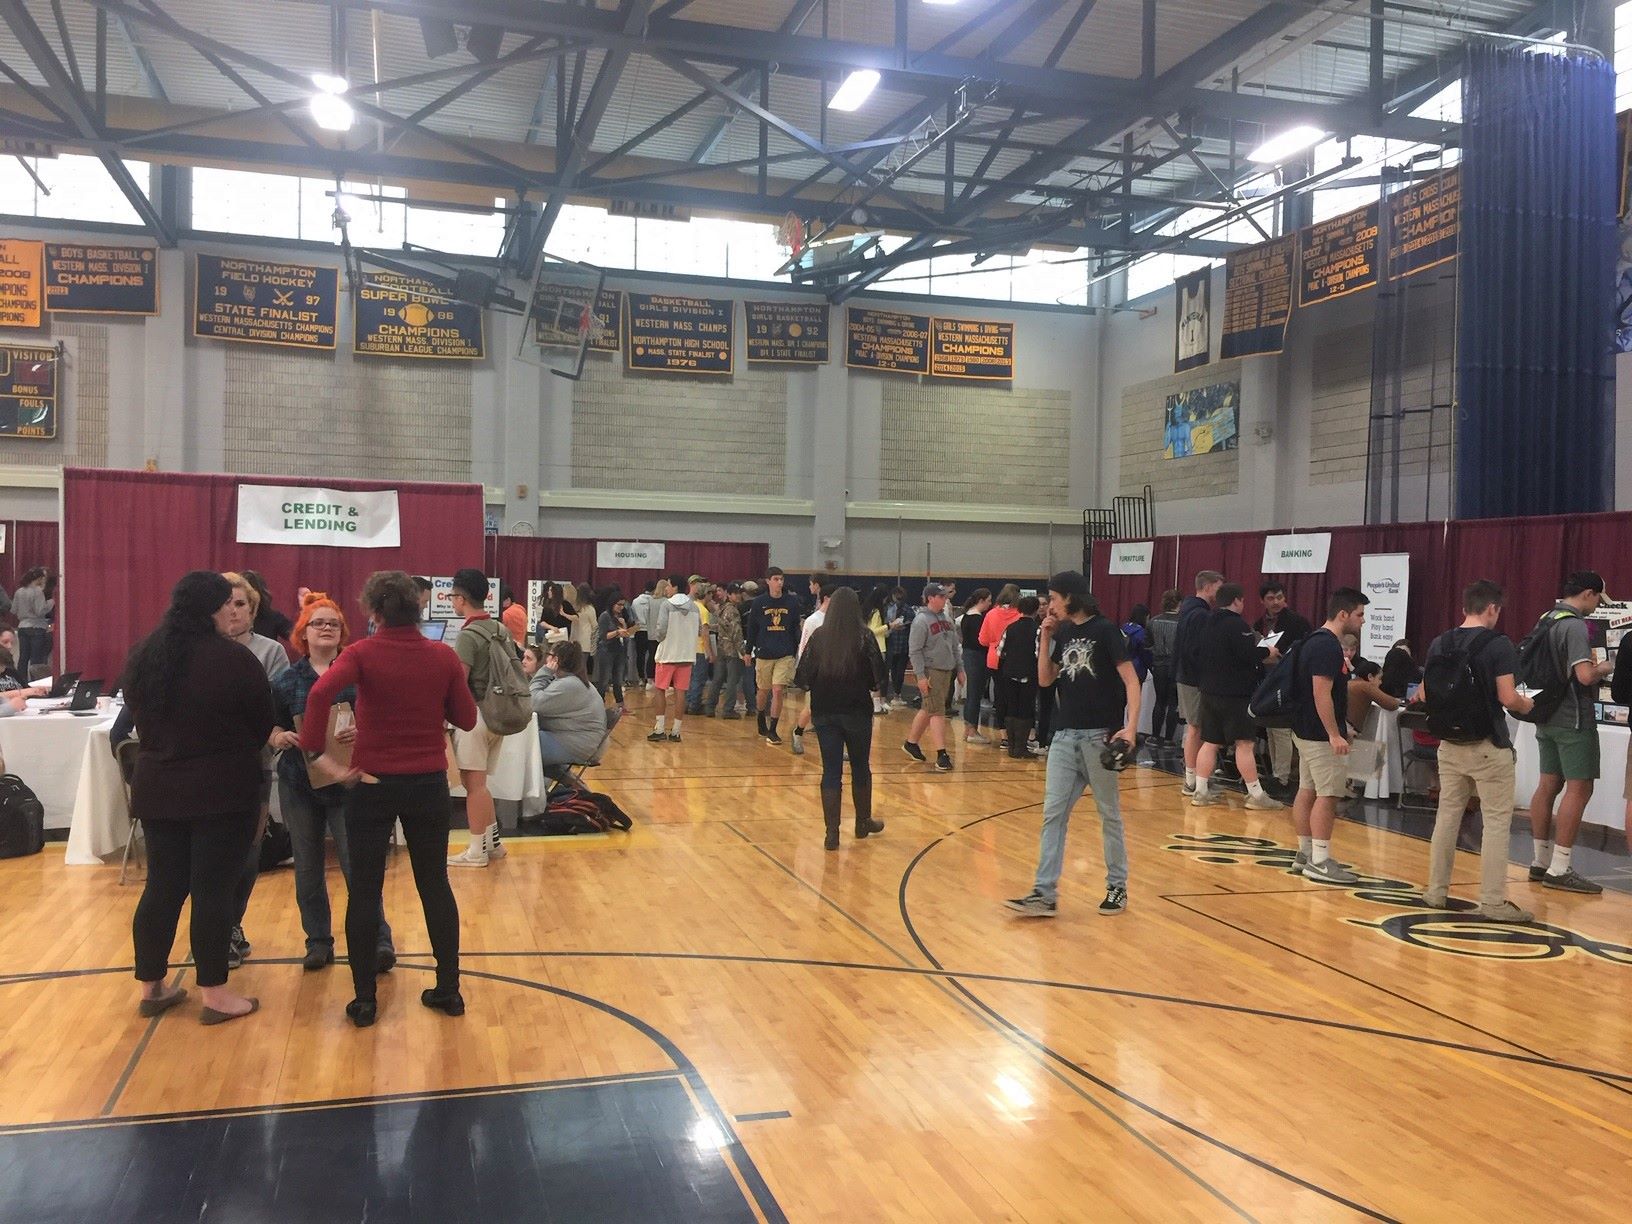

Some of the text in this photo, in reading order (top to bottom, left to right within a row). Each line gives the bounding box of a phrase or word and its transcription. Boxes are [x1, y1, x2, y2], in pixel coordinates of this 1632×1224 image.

[60, 248, 140, 260] BOYS BASKETBALL
[52, 260, 84, 271] WESTERN
[112, 263, 142, 273] DIVISION
[220, 260, 316, 278] NORTHAMPTON
[1313, 254, 1364, 279] CHAMPIONS
[58, 274, 144, 286] CHAMPIONS
[222, 271, 314, 288] FIELD HOCKEY
[214, 286, 227, 296] 19
[360, 290, 408, 302] SUPER
[651, 296, 711, 308] BASKETBALL
[215, 303, 318, 322] STATE FINALIST
[384, 307, 396, 316] 19
[640, 304, 669, 312] GIRLS
[672, 305, 714, 316] DIVISION
[754, 305, 821, 313] NORTHAMPTON
[200, 313, 334, 335] WESTERN MASSACHUSETTS CHAMPIONS
[776, 314, 822, 322] BASKETBALL
[379, 324, 460, 338] CHAMPIONS
[635, 318, 670, 329] WESTERN
[698, 323, 728, 334] CHAMPS
[756, 324, 768, 334] 19
[806, 326, 819, 336] 92
[214, 325, 319, 343] CENTRAL DIVISION CHAMPIONS
[938, 332, 1008, 346] WESTERN MASSACHUSETTS
[368, 334, 403, 344] WESTERN
[432, 337, 466, 347] DIVISION
[632, 336, 729, 350] NORTHAMPTON HIGH SCHOOL
[360, 342, 478, 356] SUBURBAN LEAGUE CHAMPIONS
[862, 343, 914, 354] CHAMPIONS
[942, 344, 1004, 356] CHAMPIONS
[13, 351, 52, 360] VISITOR
[12, 384, 38, 394] BONUS
[20, 400, 44, 408] FOULS
[16, 426, 46, 436] POINTS
[282, 502, 359, 516] CREDIT &
[284, 518, 357, 532] LENDING
[1280, 550, 1313, 558] BANKING
